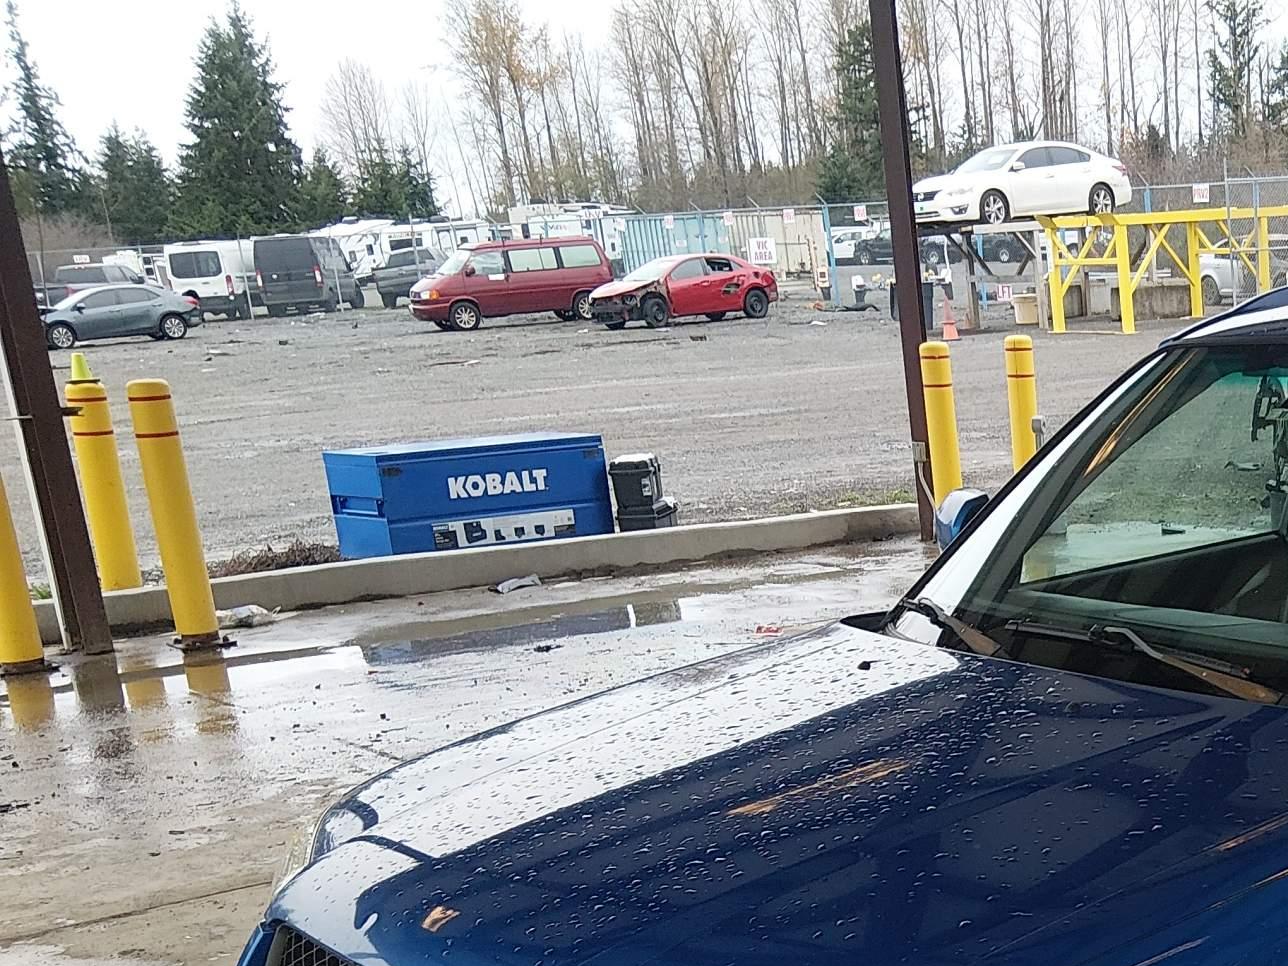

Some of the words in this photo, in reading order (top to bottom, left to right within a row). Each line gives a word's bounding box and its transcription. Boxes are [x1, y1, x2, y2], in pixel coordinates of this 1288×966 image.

[756, 240, 768, 250] VIC
[754, 250, 773, 261] AREA
[447, 469, 548, 499] KOBALT
